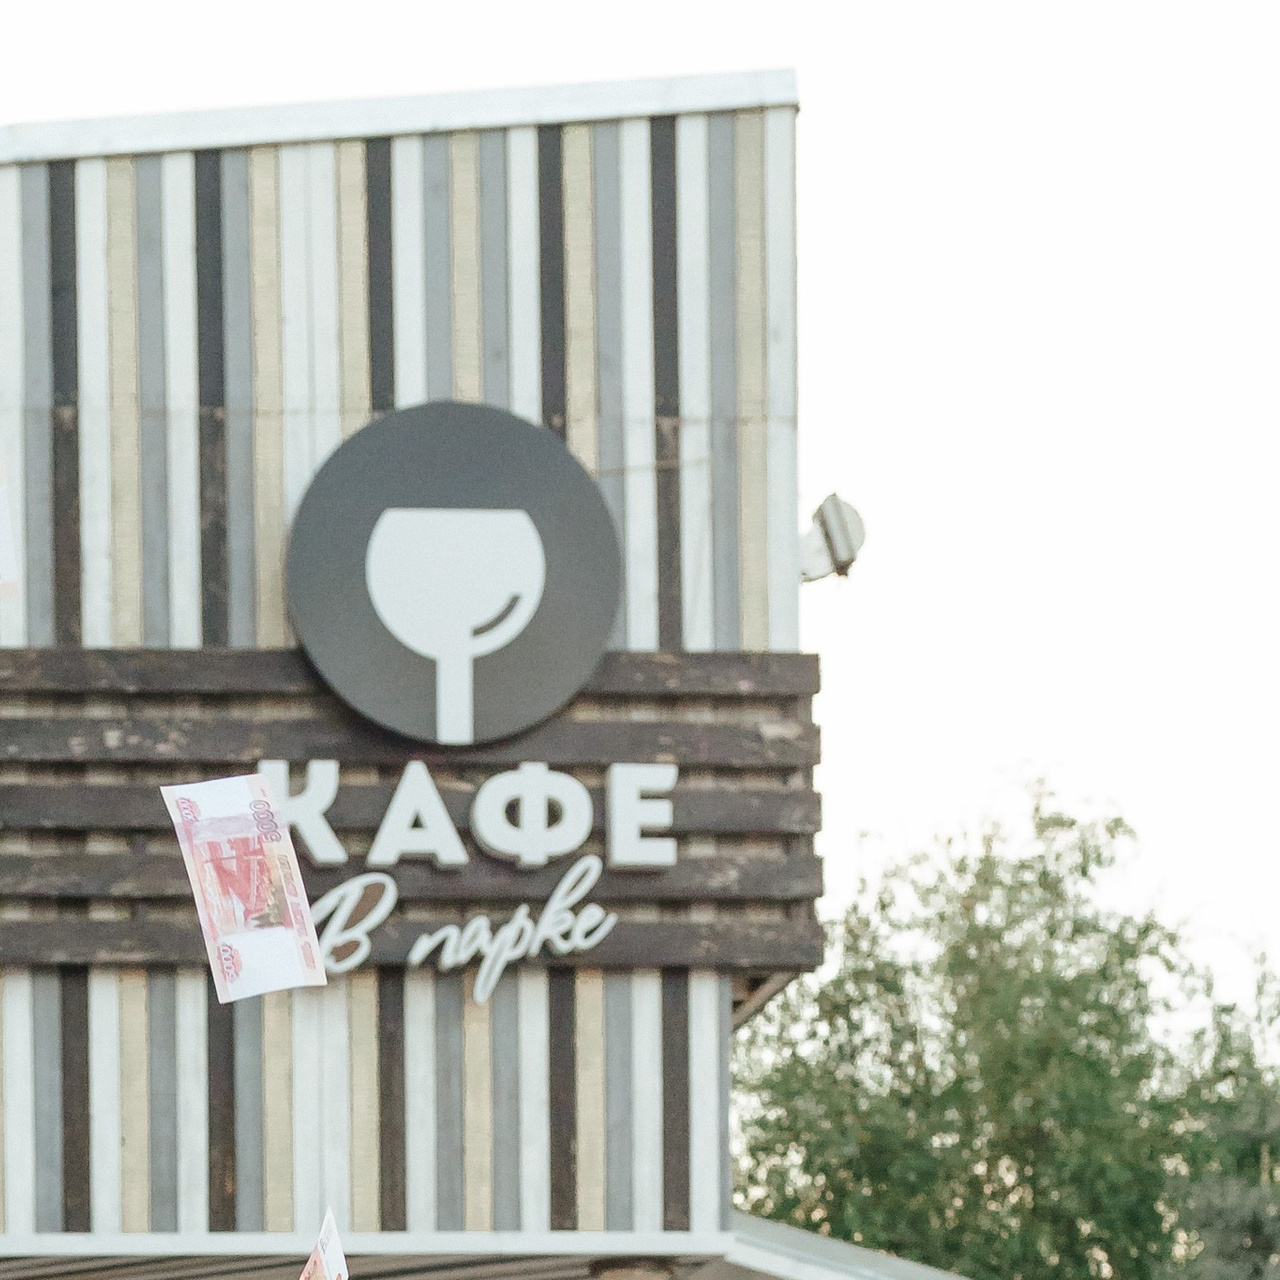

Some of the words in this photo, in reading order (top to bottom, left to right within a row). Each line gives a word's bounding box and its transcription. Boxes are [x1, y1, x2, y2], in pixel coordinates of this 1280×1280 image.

[257, 759, 679, 867] КАФЕ
[312, 871, 398, 974] В
[408, 854, 618, 1004] парке
